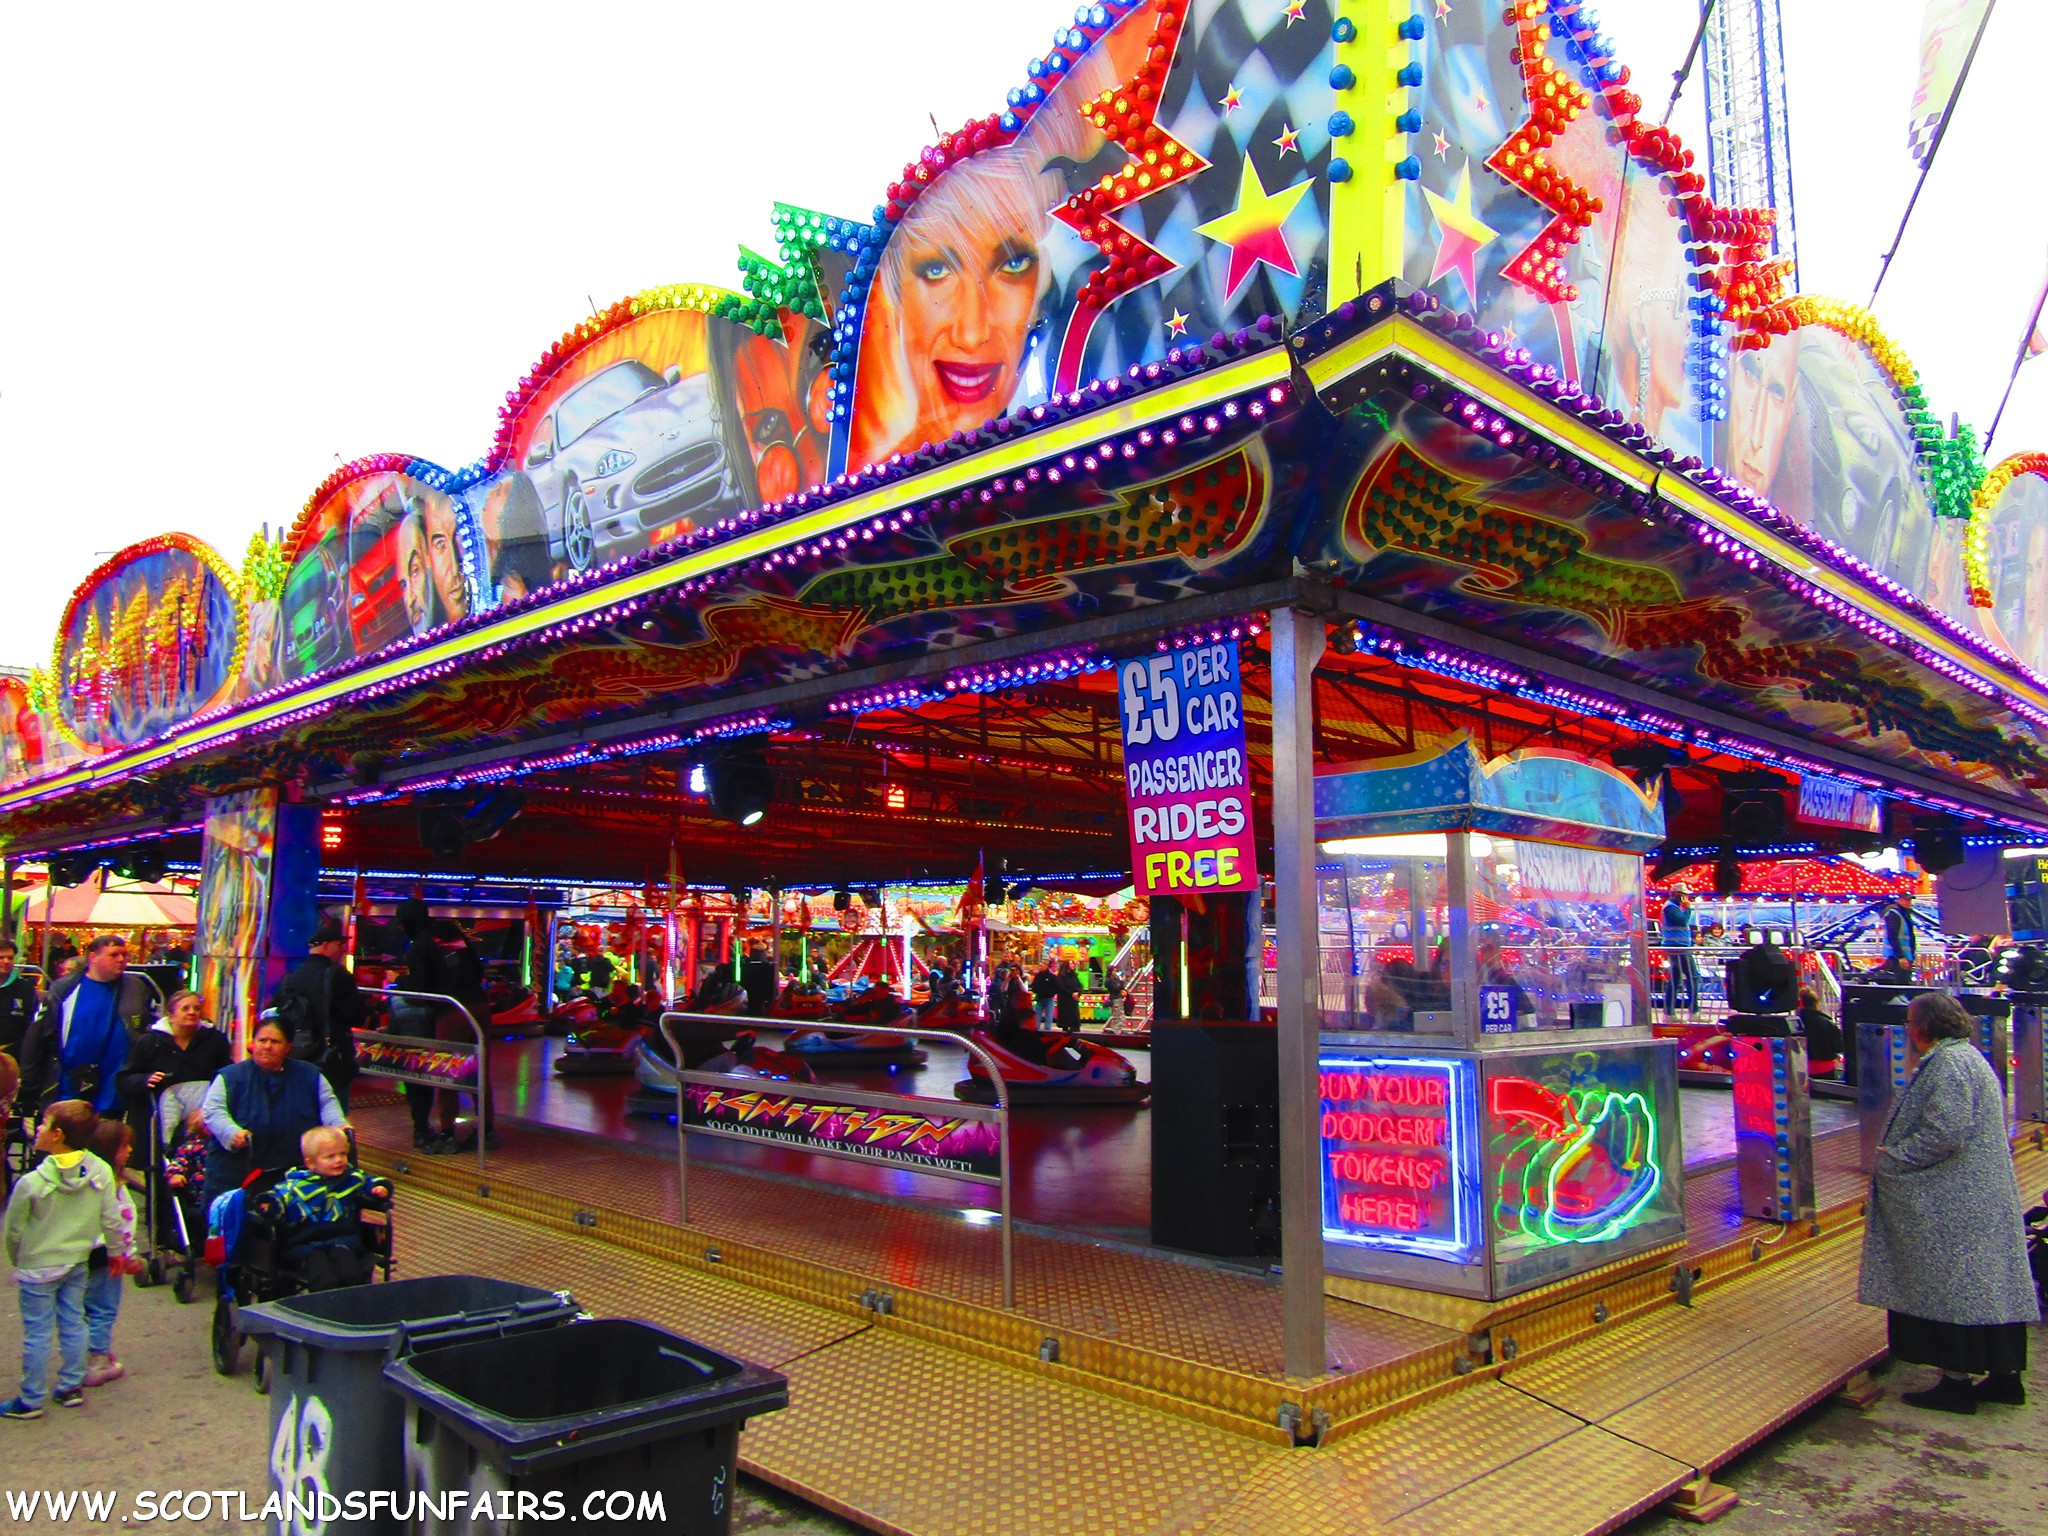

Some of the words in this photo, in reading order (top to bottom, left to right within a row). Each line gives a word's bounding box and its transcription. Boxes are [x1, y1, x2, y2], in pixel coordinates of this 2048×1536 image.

[1123, 655, 1180, 746] £5
[1182, 644, 1231, 688] PER
[1186, 691, 1239, 735] CAR
[1128, 748, 1243, 798] PASSENGER
[1133, 797, 1246, 843] RIDES
[1145, 848, 1242, 890] FREE
[1487, 991, 1510, 1020] £5
[1485, 1024, 1499, 1033] PER
[1499, 1023, 1512, 1033] CAR
[1369, 1076, 1443, 1106] YOUR
[706, 1119, 721, 1130] SO
[722, 1122, 760, 1137] GOOD
[762, 1128, 775, 1139] IT
[807, 1136, 842, 1150] MAKE
[845, 1142, 883, 1158] YOUR
[887, 1149, 932, 1166] PANTS
[1322, 1114, 1435, 1147] DODGEM
[1328, 1153, 1432, 1190] TOKENS
[1342, 1194, 1418, 1231] HERE!
